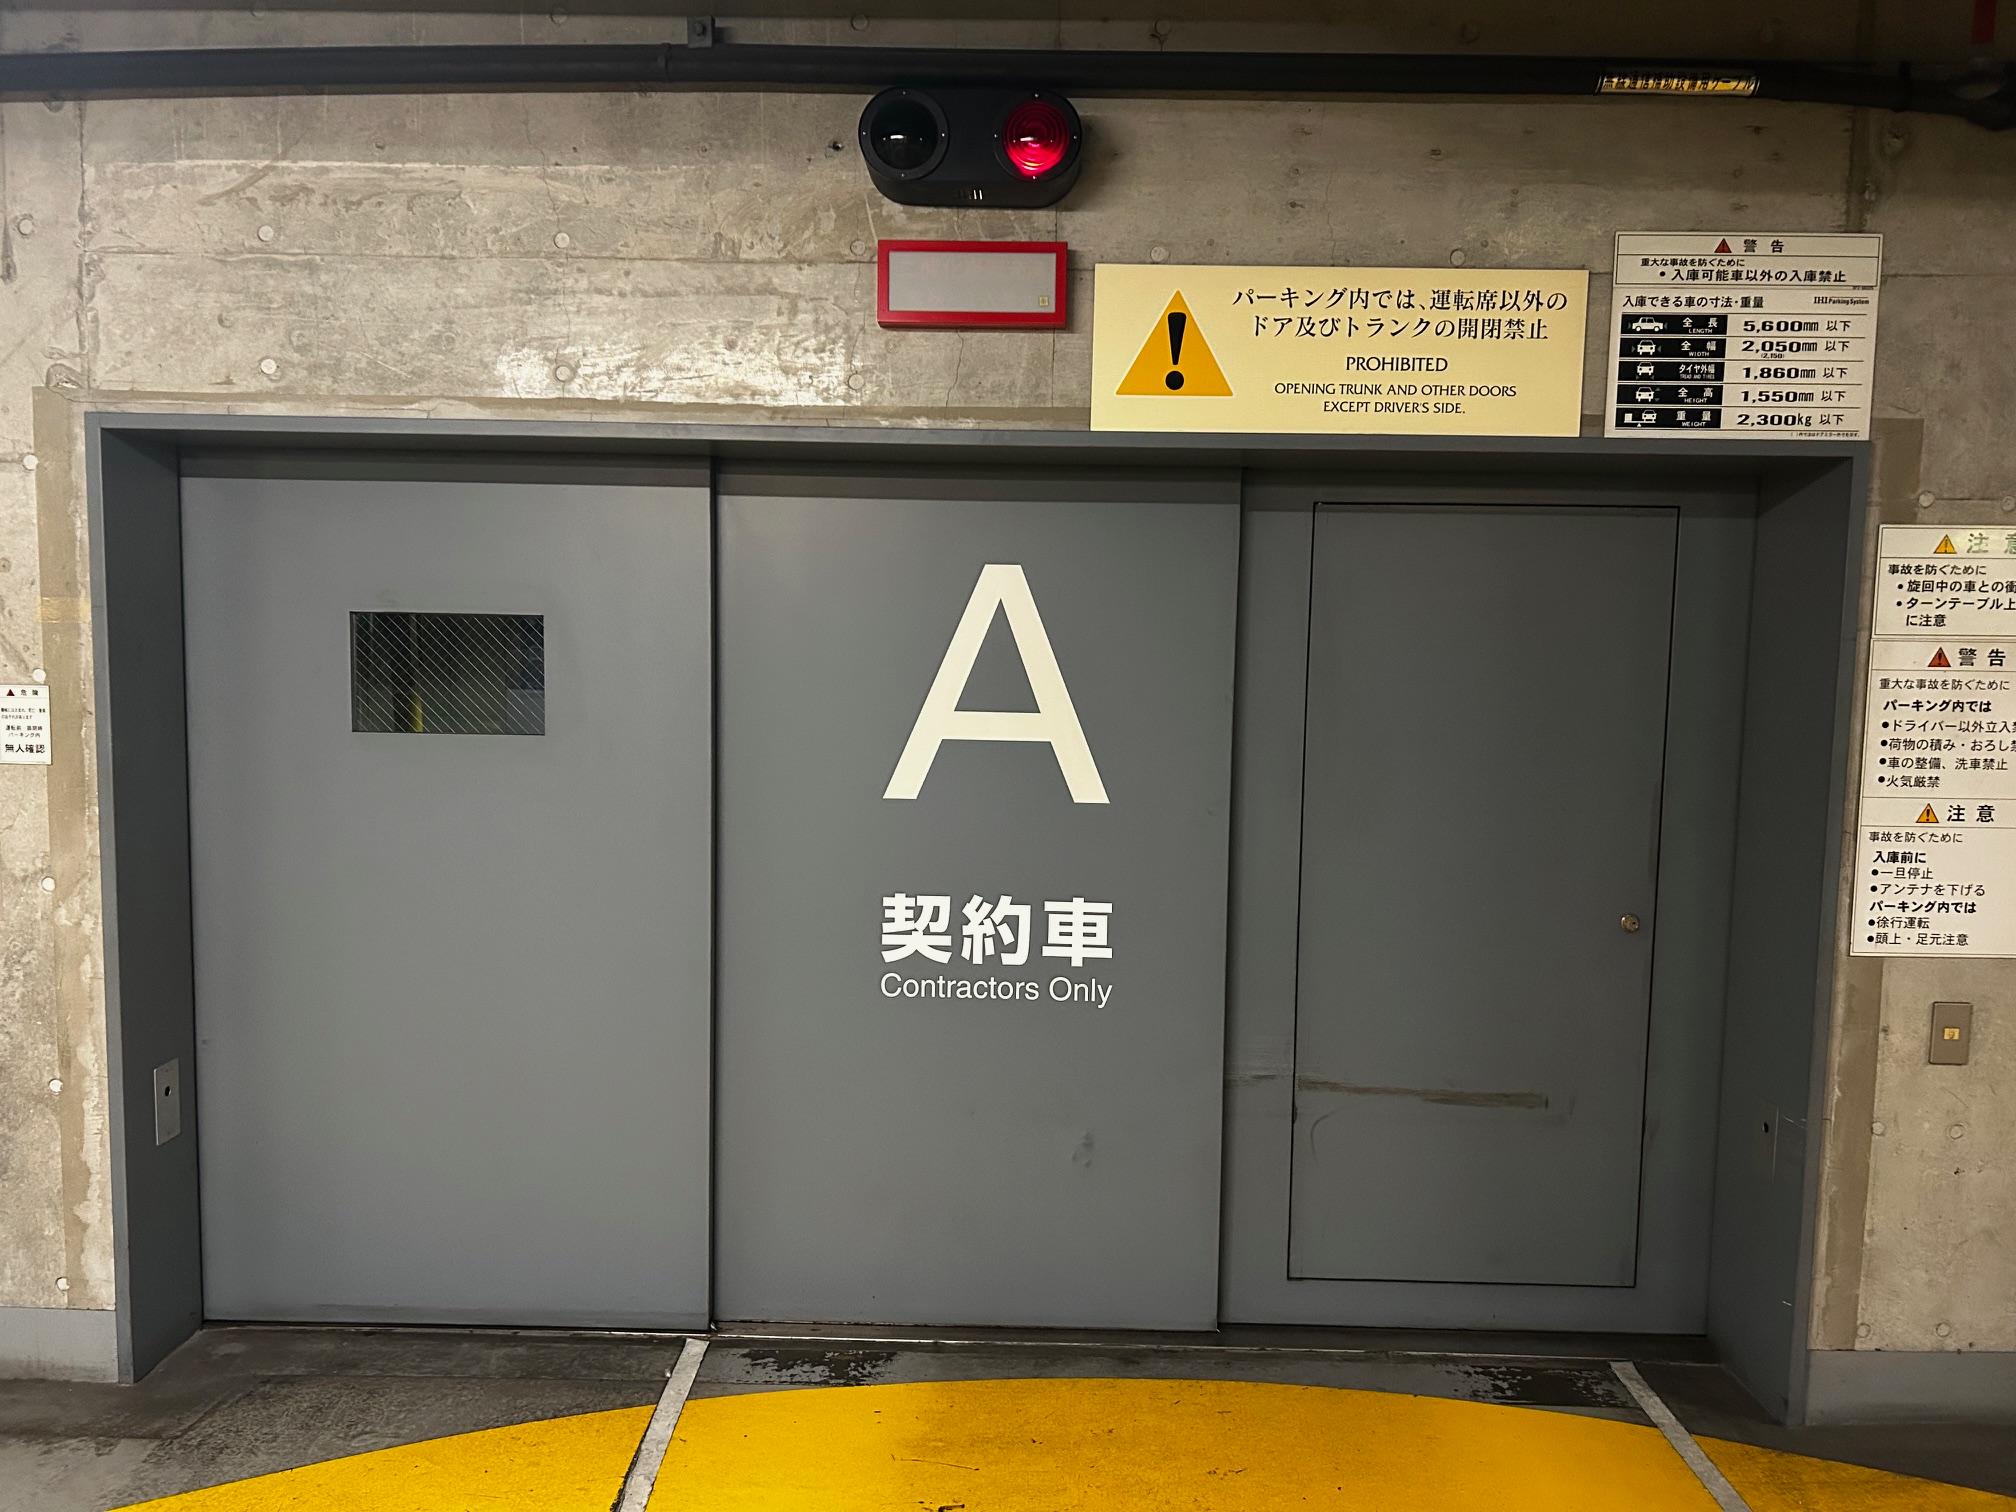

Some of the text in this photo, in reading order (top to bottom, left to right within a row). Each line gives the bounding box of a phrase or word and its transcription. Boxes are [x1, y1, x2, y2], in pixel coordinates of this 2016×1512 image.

[1743, 238, 1785, 254] 警告
[1640, 257, 1745, 267] 重大な事故を防ぐために
[1671, 269, 1847, 283] 入庫可能車以外の入庫禁止
[1232, 287, 1568, 312] パーキング内では、運転席以外の
[1622, 295, 1764, 309] 入庫できる車の寸法・重量
[1254, 315, 1549, 340] ドア及びトランクの開閉禁止
[1682, 317, 1718, 328] 全長
[1742, 319, 1852, 334] 5,600mm 以下
[1681, 340, 1717, 351] 全幅
[1741, 340, 1850, 354] 2,050mm 以下
[1345, 356, 1449, 372] PROHIBITED
[1678, 363, 1716, 374] タイヤ外幅
[1742, 366, 1848, 381] 1,860mm 以下
[1274, 382, 1517, 398] OPENING TRUNK AND OTHER DOORS
[1677, 386, 1714, 398] 全高
[1740, 390, 1846, 404] 1,550mm 以下
[1323, 401, 1467, 415] EXCEPT DRIVER'S SIDE.
[1676, 410, 1712, 421] 重量
[1737, 413, 1845, 428] 2,300kg 以下
[1888, 563, 1987, 576] 事故を防ぐために
[1906, 597, 2016, 611] ターンテーブル上
[1905, 613, 1947, 627] に注意
[1958, 647, 2007, 667] 警告
[881, 563, 1111, 804] A
[1879, 677, 2010, 691] 重大な事故を防ぐために
[1883, 699, 1992, 713] パーキング内では
[5, 743, 46, 754] 無人確認
[1887, 757, 2009, 771] 車の整備、洗車禁止
[1886, 774, 1941, 788] 火気厳禁
[1946, 804, 1995, 823] 注意
[1868, 831, 1963, 844] 事故を防ぐために
[1872, 850, 1927, 864] 入庫前に
[1880, 867, 1934, 880] 一旦停止
[1879, 883, 1986, 897] アンテナを下げる
[1869, 900, 1977, 914] パーキング内では
[880, 892, 1113, 968] 契約車
[1876, 916, 1931, 930] 徐行運転
[1874, 932, 1969, 947] 頭上・足元注意
[880, 972, 1113, 1009] Contractors Only
